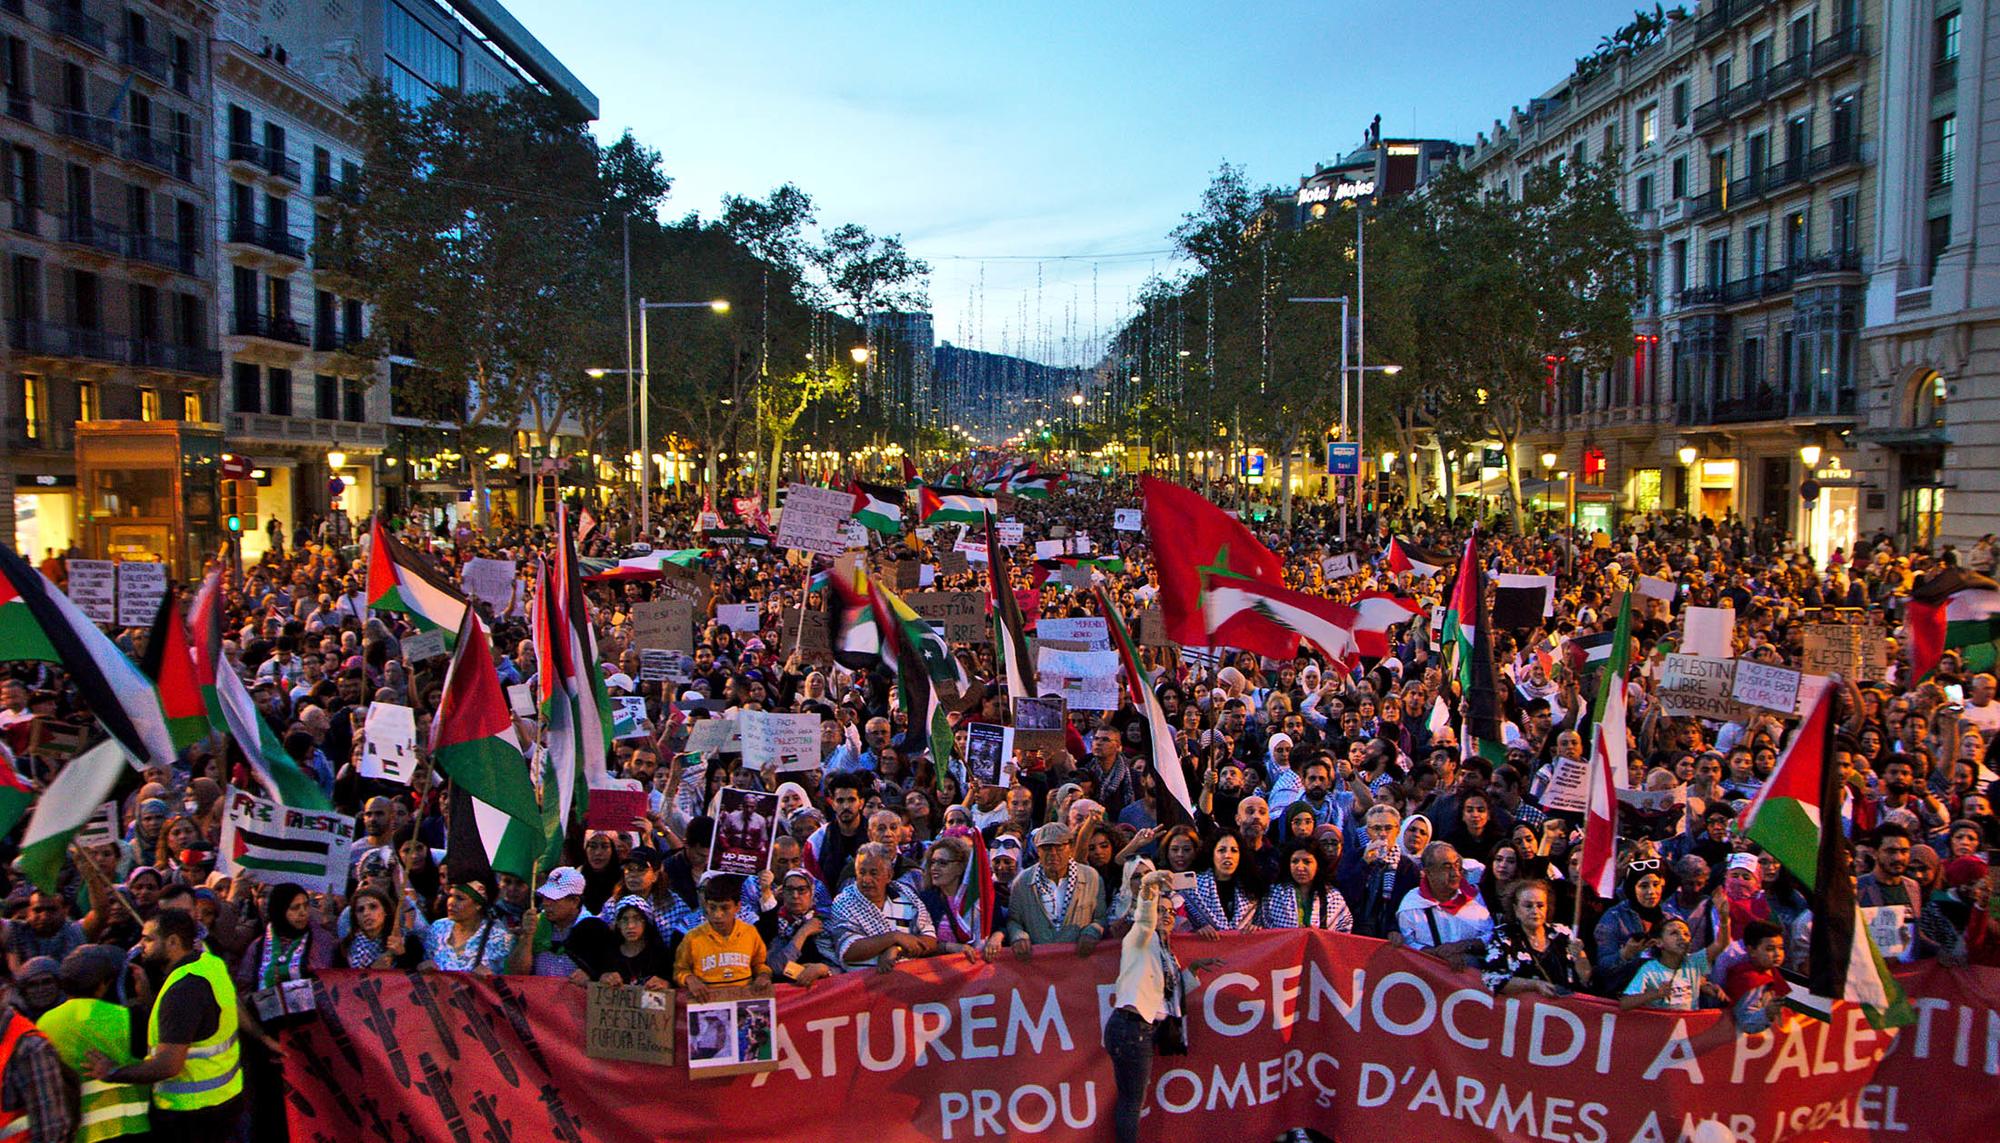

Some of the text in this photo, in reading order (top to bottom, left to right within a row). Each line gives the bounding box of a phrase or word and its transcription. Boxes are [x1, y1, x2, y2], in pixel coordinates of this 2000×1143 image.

[1297, 186, 1330, 206] Hotel
[1668, 656, 1733, 679] PALESTIN
[1670, 677, 1708, 696] LIBRE
[702, 954, 716, 972] LOS
[597, 986, 640, 1009] ISRAEL
[751, 984, 1075, 1088] ATUREM
[1203, 960, 1617, 1074] GENOCIDI
[1642, 1017, 1705, 1085] A
[940, 1080, 1097, 1141] PROU
[1139, 1049, 1340, 1119] OMERÇ
[1357, 1062, 1609, 1143] D'ARMES
